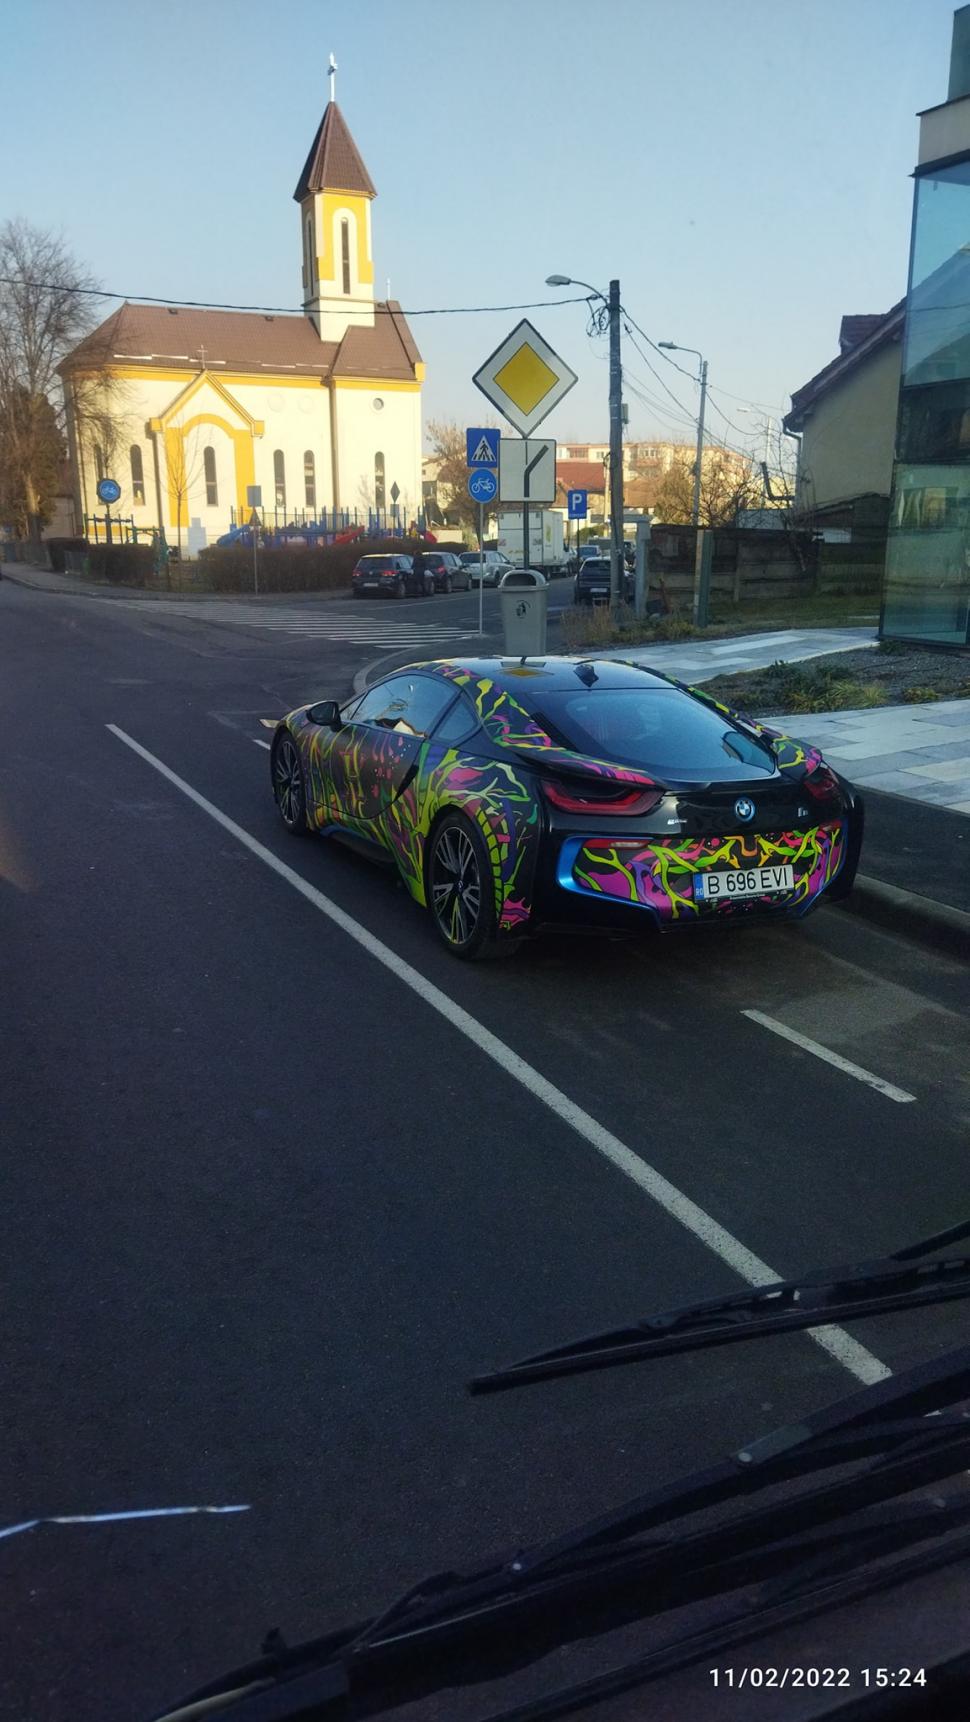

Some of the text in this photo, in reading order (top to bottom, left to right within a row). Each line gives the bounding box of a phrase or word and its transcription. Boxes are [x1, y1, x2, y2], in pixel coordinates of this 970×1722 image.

[572, 493, 582, 511] P
[708, 867, 788, 895] B 696 EVI
